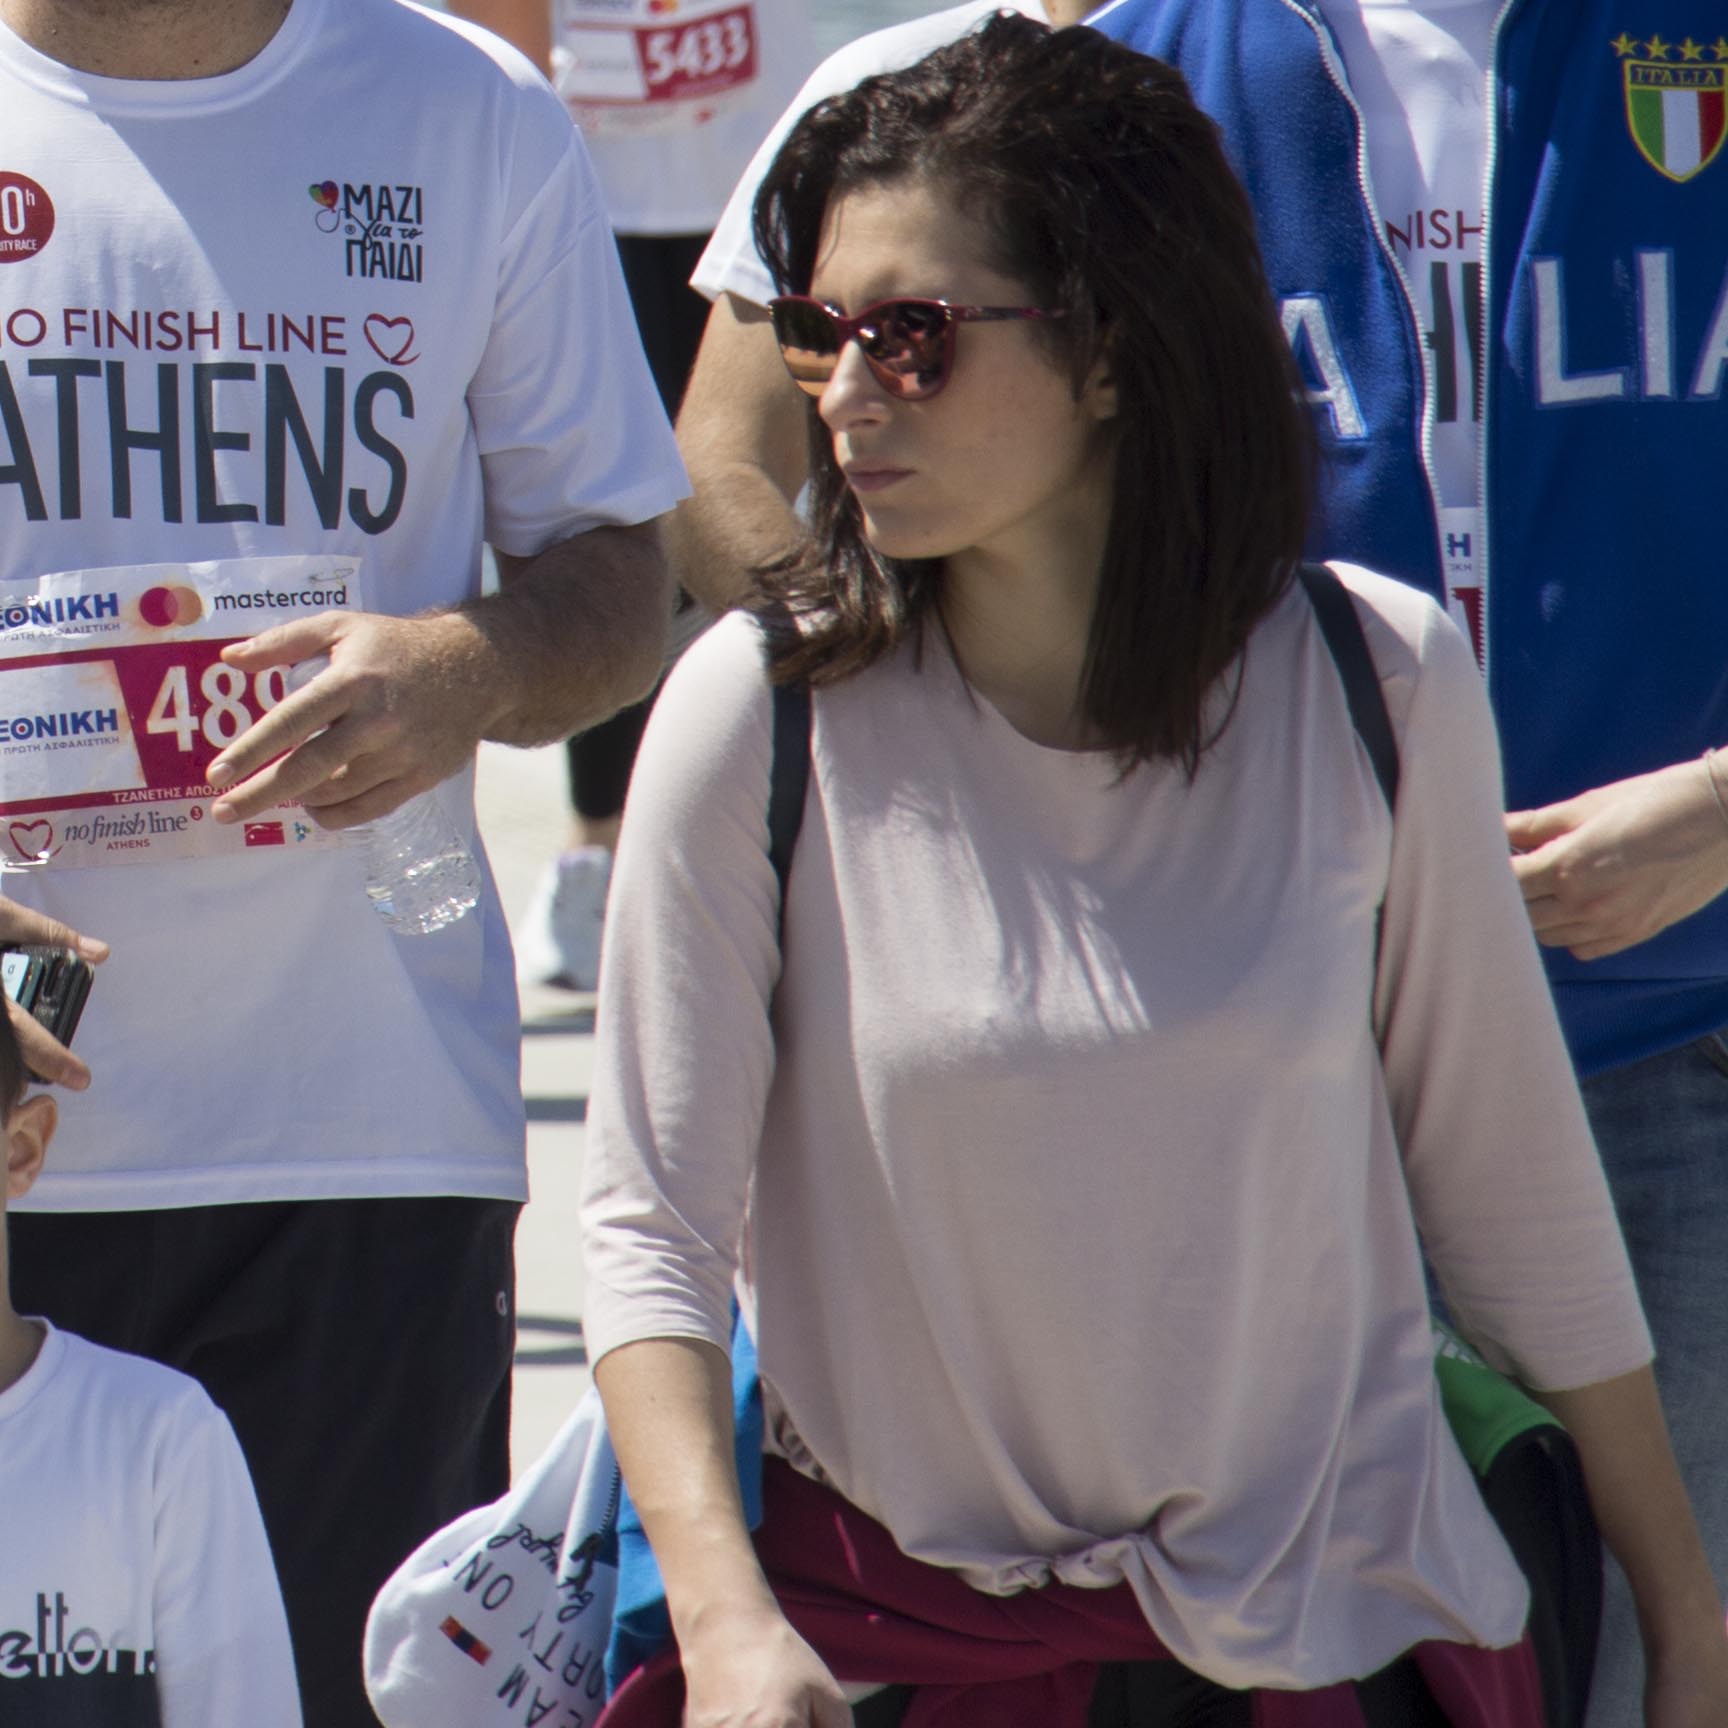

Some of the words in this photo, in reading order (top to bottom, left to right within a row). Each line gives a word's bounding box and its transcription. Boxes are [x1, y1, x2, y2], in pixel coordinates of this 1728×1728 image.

[1635, 67, 1717, 84] ITALIA
[15, 238, 38, 251] RACE
[63, 308, 220, 352] FINISH
[237, 313, 347, 356] LINE
[213, 585, 347, 610] mastercard
[65, 821, 92, 842] no
[88, 814, 146, 846] finish
[148, 809, 188, 835] line
[106, 839, 151, 852] ATHENS
